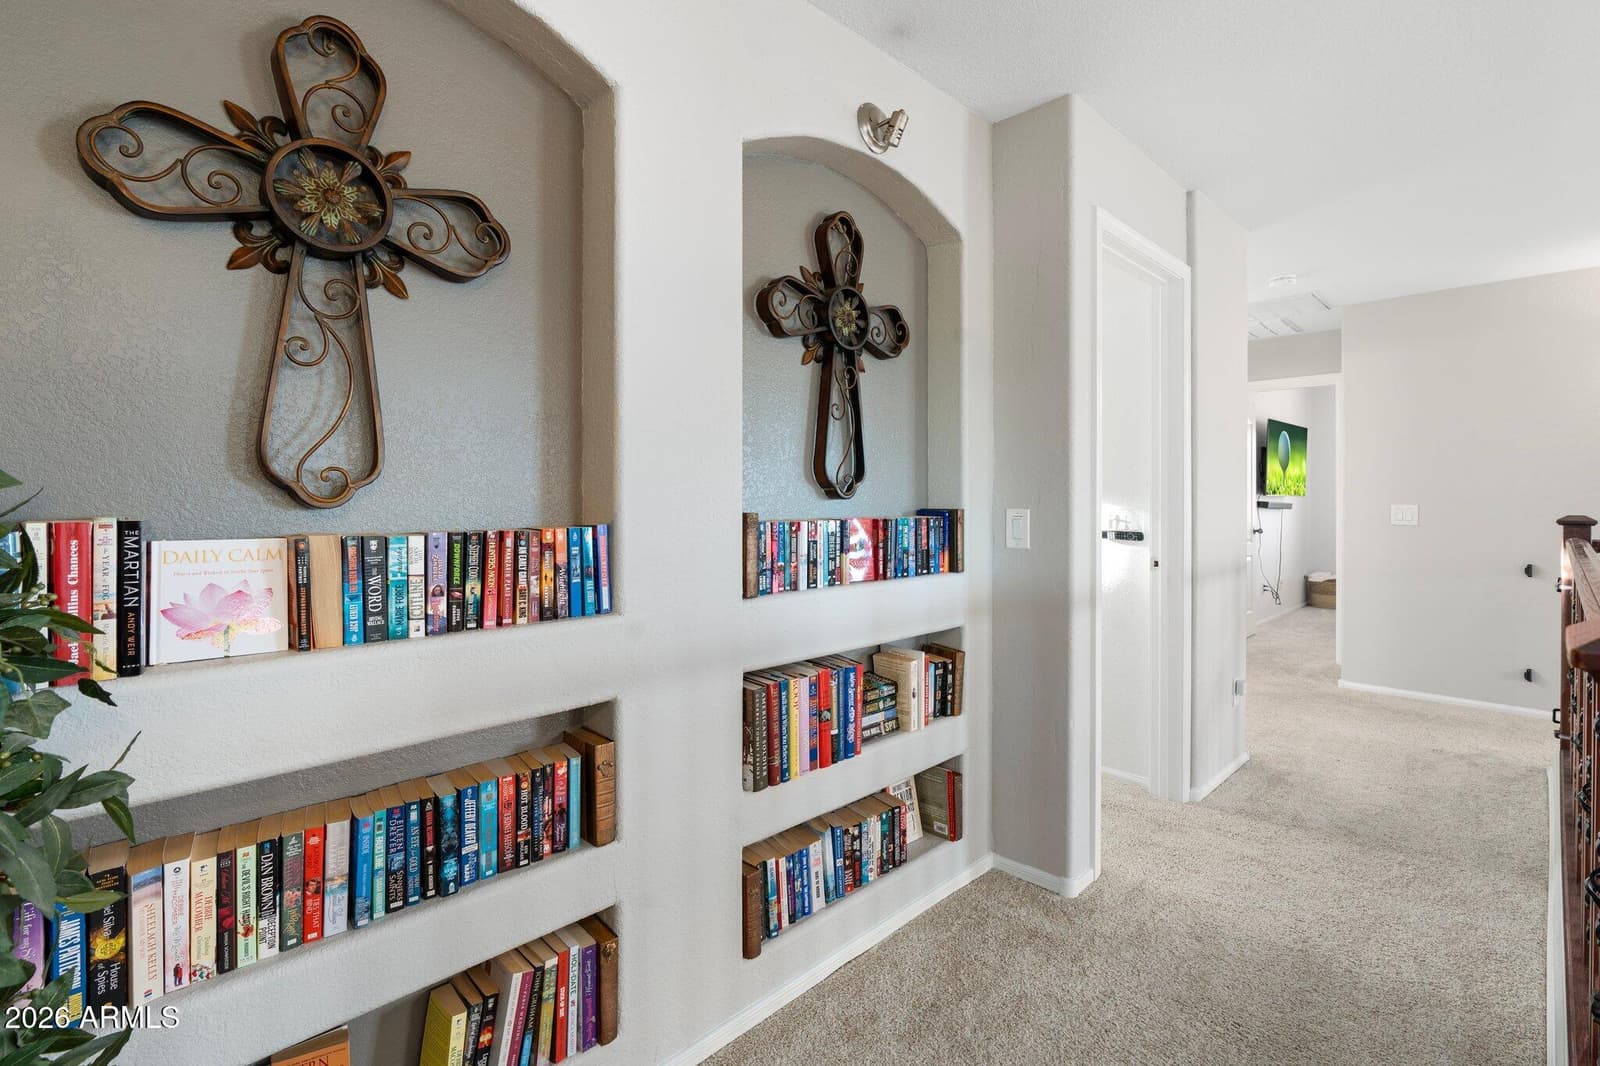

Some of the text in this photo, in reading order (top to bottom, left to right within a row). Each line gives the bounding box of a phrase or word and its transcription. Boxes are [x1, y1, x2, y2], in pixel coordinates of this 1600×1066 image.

[67, 539, 79, 585] Chances
[162, 547, 283, 565] DAILY CALM
[469, 543, 480, 567] STEPHEN
[505, 546, 513, 576] MANDARIN
[518, 546, 527, 588] AN EARLY GRAVE
[123, 536, 140, 607] MARTIAN
[488, 571, 496, 588] MOON
[368, 575, 382, 612] WORD
[395, 584, 403, 625] MARIE FORCE
[410, 578, 424, 617] CUTLINE
[128, 612, 136, 656] ANDY WEIR
[884, 720, 896, 732] SPY
[464, 799, 477, 845] JEFFERY DEAVER
[520, 789, 528, 830] HOT BLOOD
[396, 819, 404, 850] EILEEN
[242, 869, 251, 891] DEVIL'S
[409, 856, 417, 873] GOLD
[261, 853, 274, 911] DAN BROWN
[396, 870, 404, 901] SINNERS
[194, 891, 203, 933] MACOMBER
[204, 895, 213, 921] DEBBIE
[242, 891, 251, 908] RIGHT
[58, 918, 81, 948] JAMES
[103, 916, 115, 937] Silva
[267, 917, 276, 949] DECEPTION
[312, 910, 320, 928] THAT
[144, 903, 157, 981] SHEELAGH KELLY
[259, 927, 267, 944] POINT
[96, 970, 108, 996] Spies
[110, 962, 121, 990] House
[570, 953, 578, 997] HOLI-DATE
[527, 971, 542, 1029] JOHN GRISHAM
